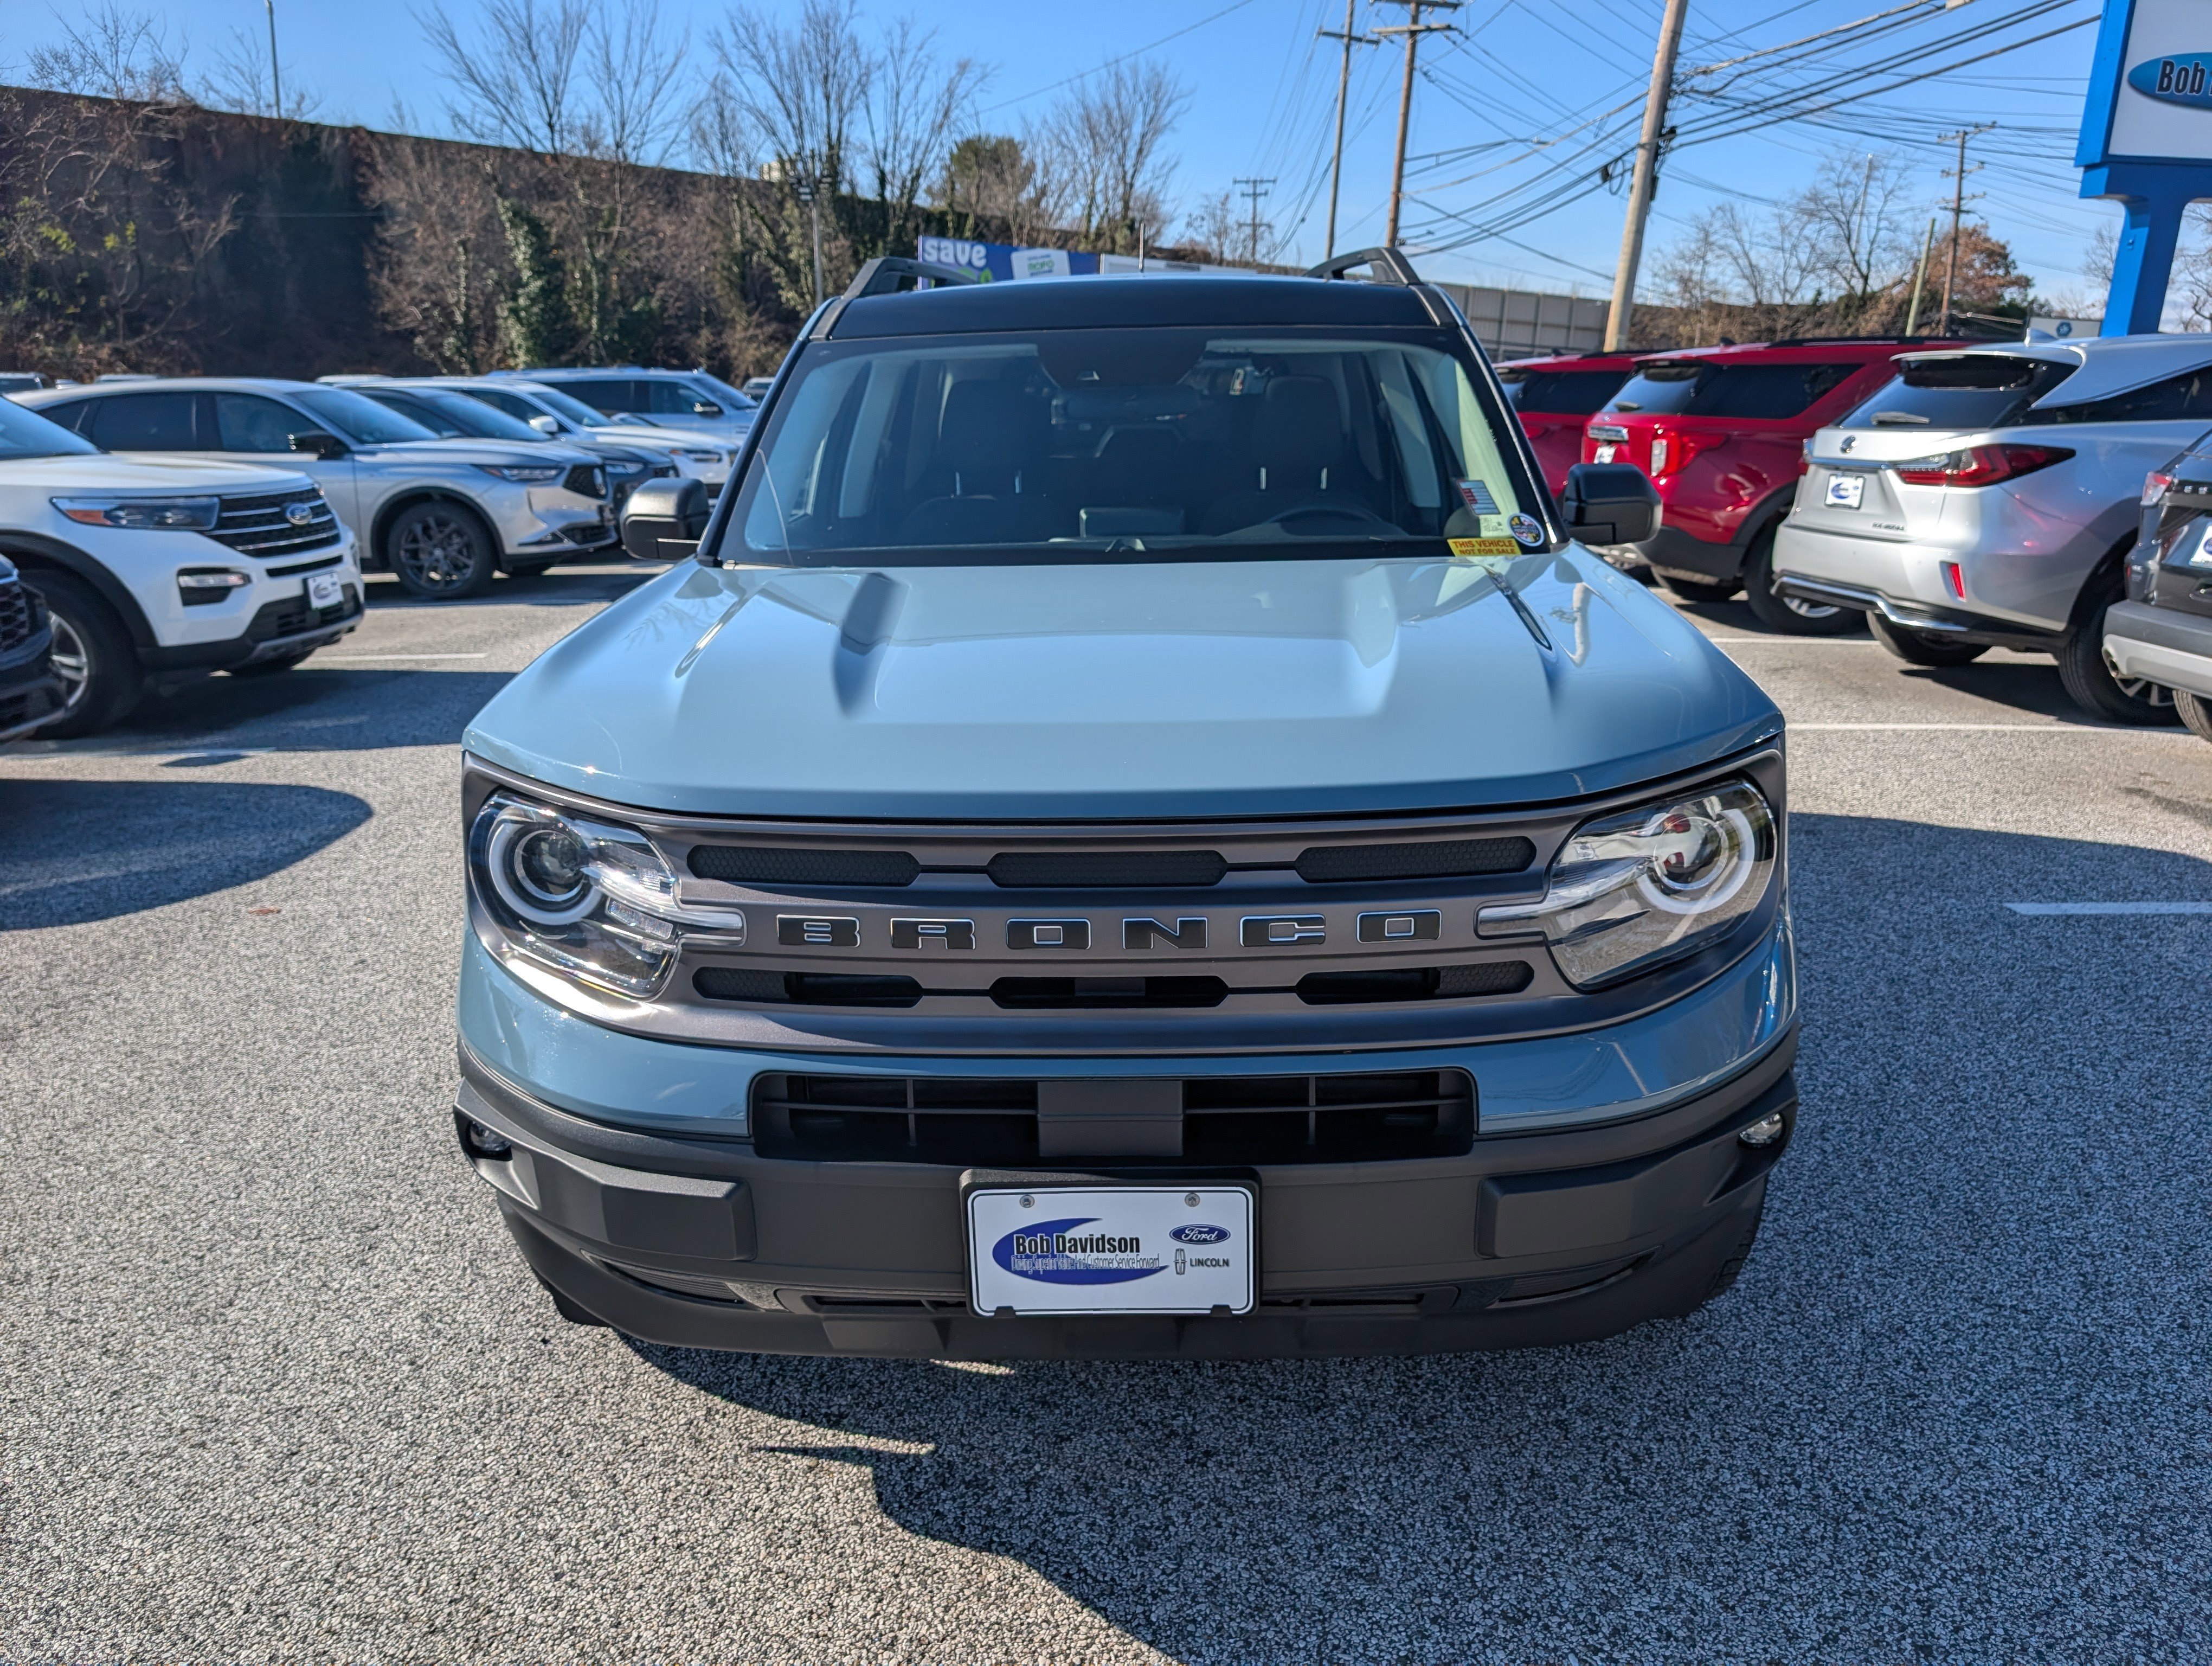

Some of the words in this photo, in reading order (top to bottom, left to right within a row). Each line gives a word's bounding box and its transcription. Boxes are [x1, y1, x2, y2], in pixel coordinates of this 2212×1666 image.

[2156, 59, 2206, 95] Bob
[922, 238, 987, 268] save
[1452, 540, 1475, 548] THIS
[776, 909, 1442, 950] BRONCO
[1181, 1227, 1219, 1241] Ford
[1014, 1234, 1051, 1255] Bob
[1054, 1233, 1140, 1253] Davidson
[1087, 1254, 1113, 1270] Customer
[1115, 1254, 1136, 1269] Service
[1136, 1253, 1160, 1270] Forward
[1189, 1258, 1230, 1267] LINCOLN
